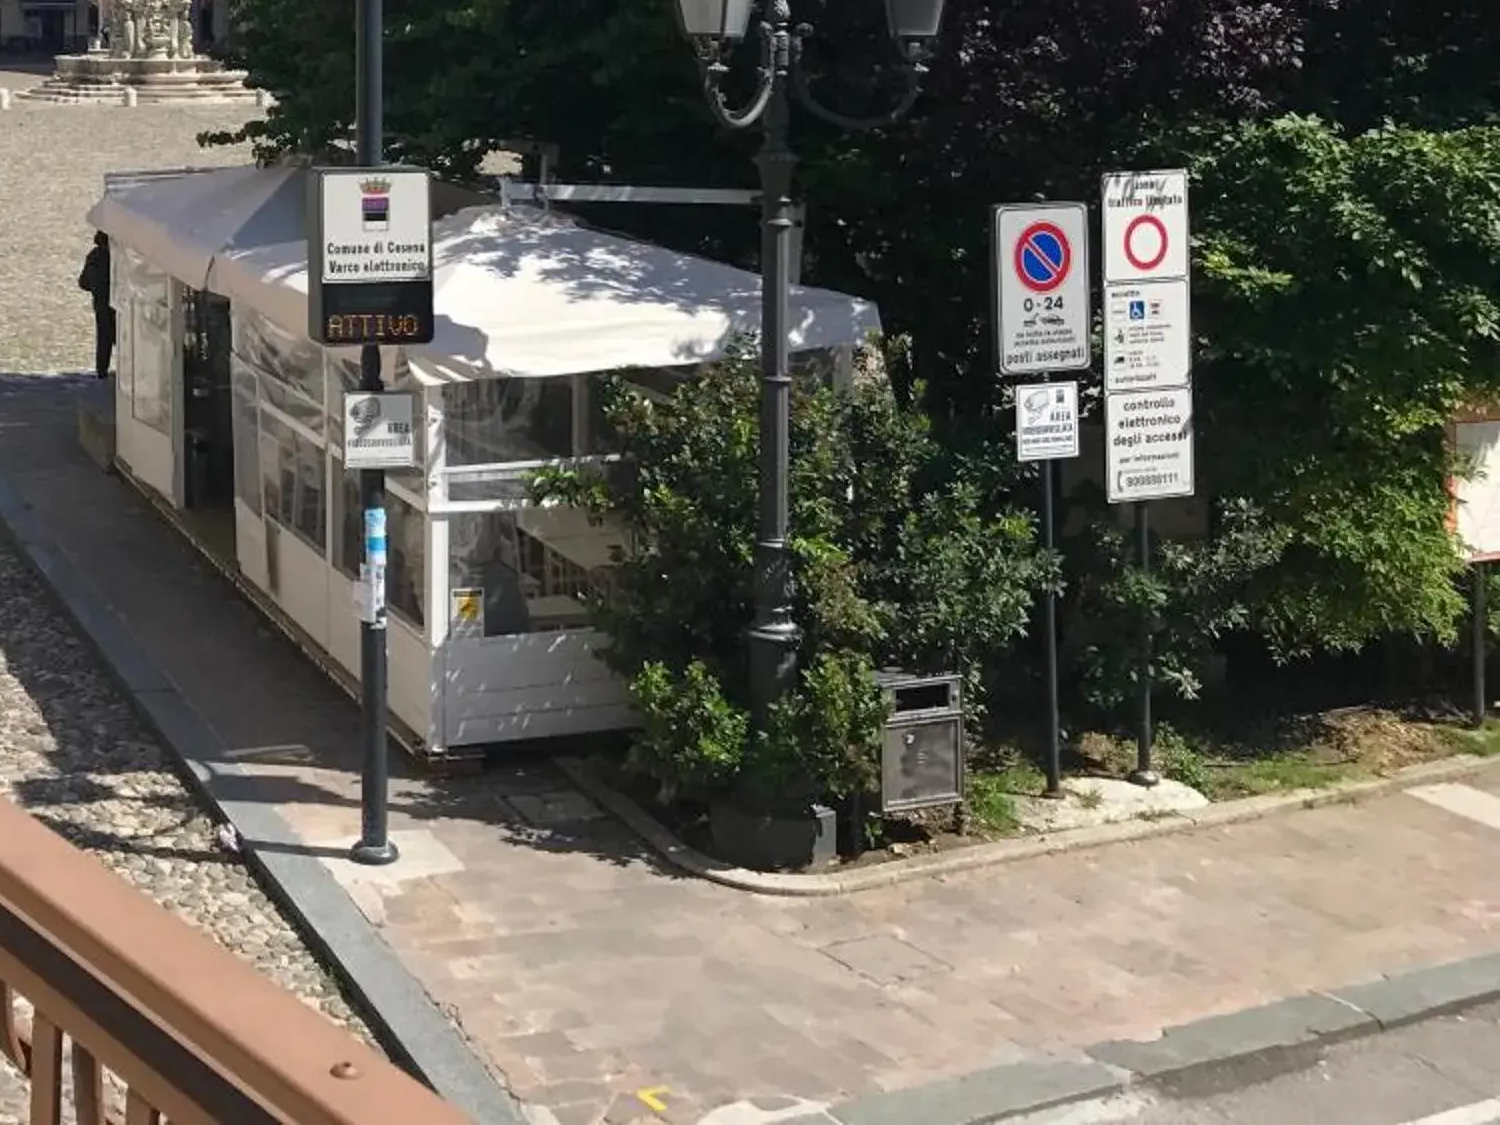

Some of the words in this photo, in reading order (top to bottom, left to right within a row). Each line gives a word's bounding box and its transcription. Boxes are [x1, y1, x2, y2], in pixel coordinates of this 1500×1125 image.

[327, 242, 370, 255] Comune
[373, 241, 383, 254] di
[387, 241, 425, 253] Cesena
[329, 260, 360, 273] Varco
[363, 258, 425, 272] elettronico
[327, 314, 419, 338] ATTIVO
[1006, 350, 1033, 366] posti
[1036, 346, 1085, 363] assegnati
[1123, 396, 1175, 412] controllo
[1118, 414, 1181, 430] elettronico
[1113, 433, 1142, 448] degli
[1145, 429, 1188, 444] accessi
